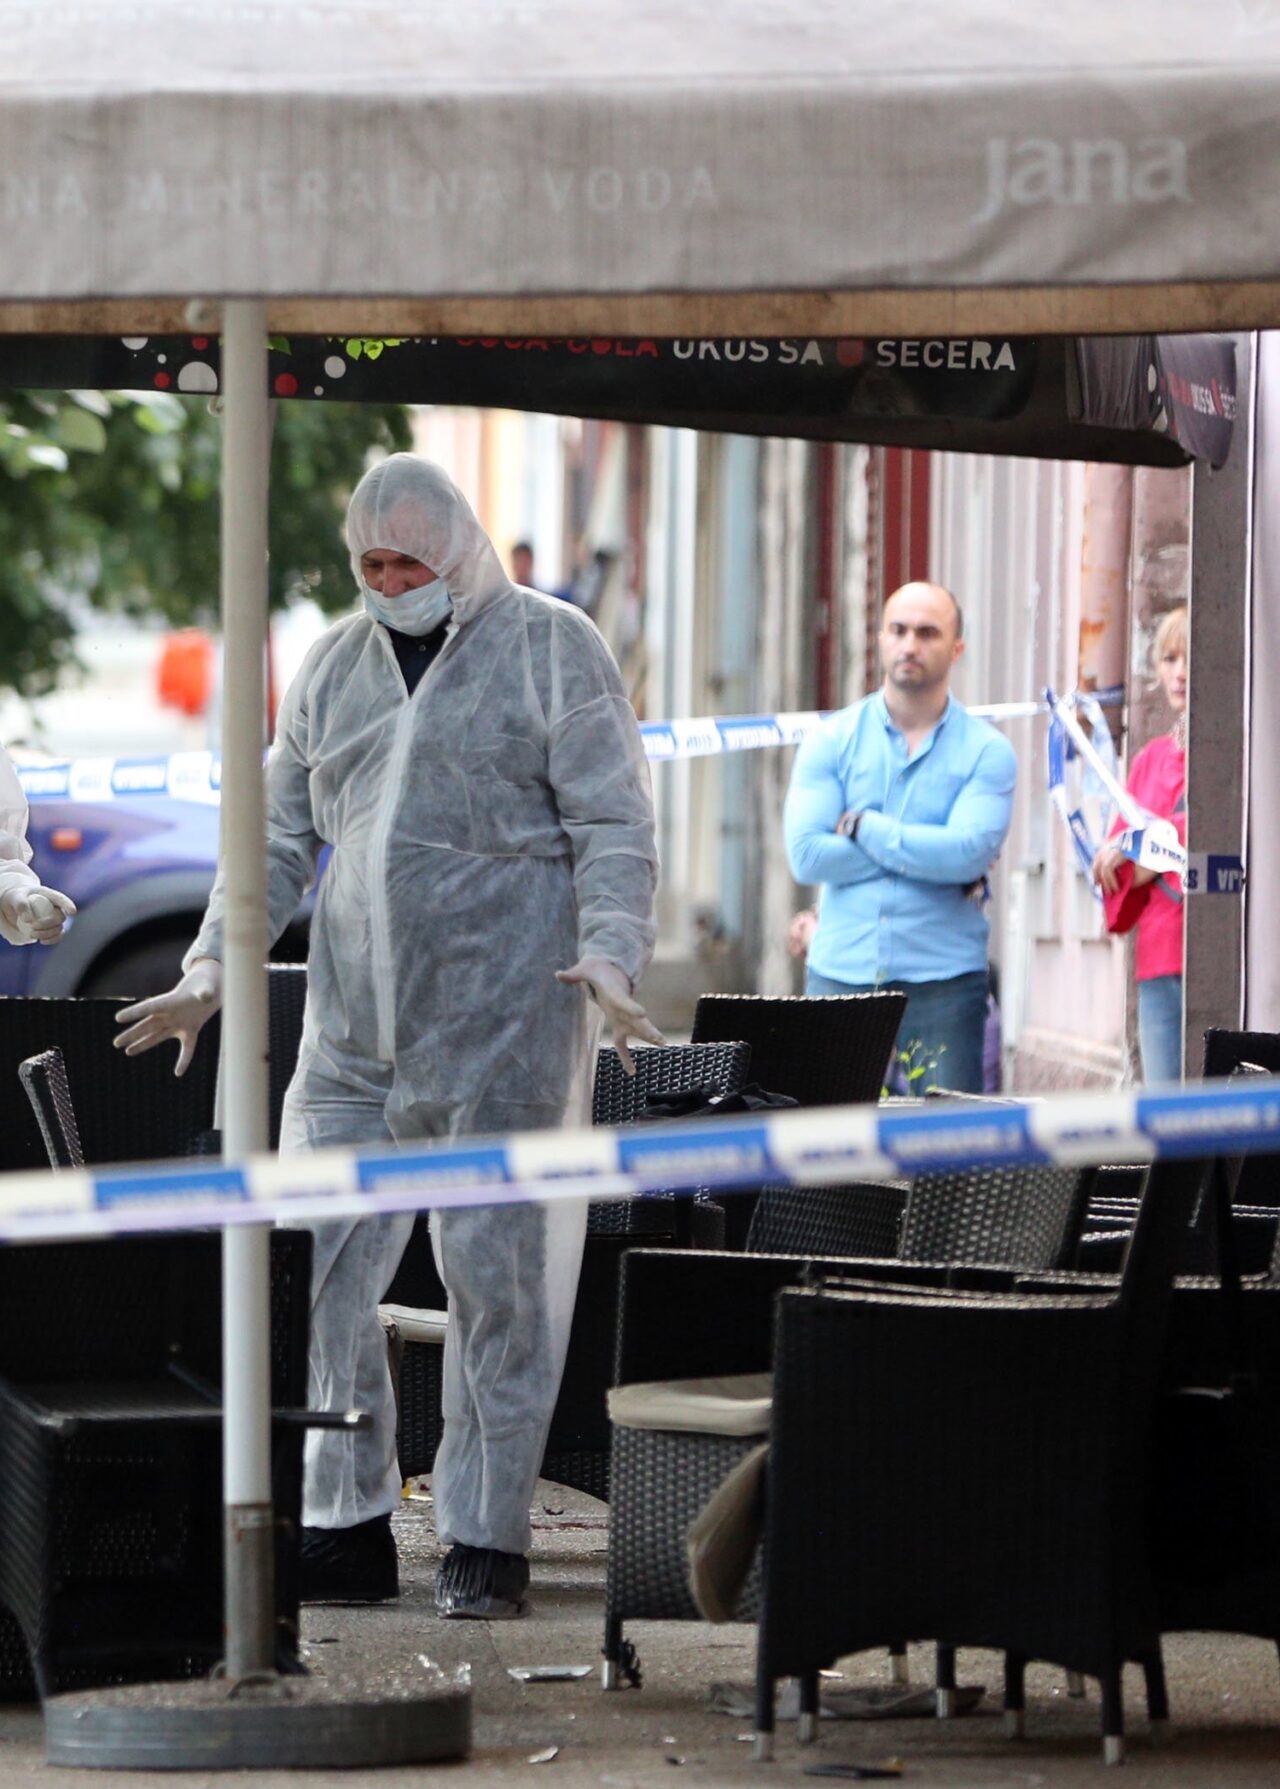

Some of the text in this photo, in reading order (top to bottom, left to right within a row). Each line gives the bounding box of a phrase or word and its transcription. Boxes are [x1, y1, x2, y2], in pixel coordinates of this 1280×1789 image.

[125, 169, 506, 216] MINERALNA
[543, 165, 719, 212] VODA
[777, 340, 824, 366] SA
